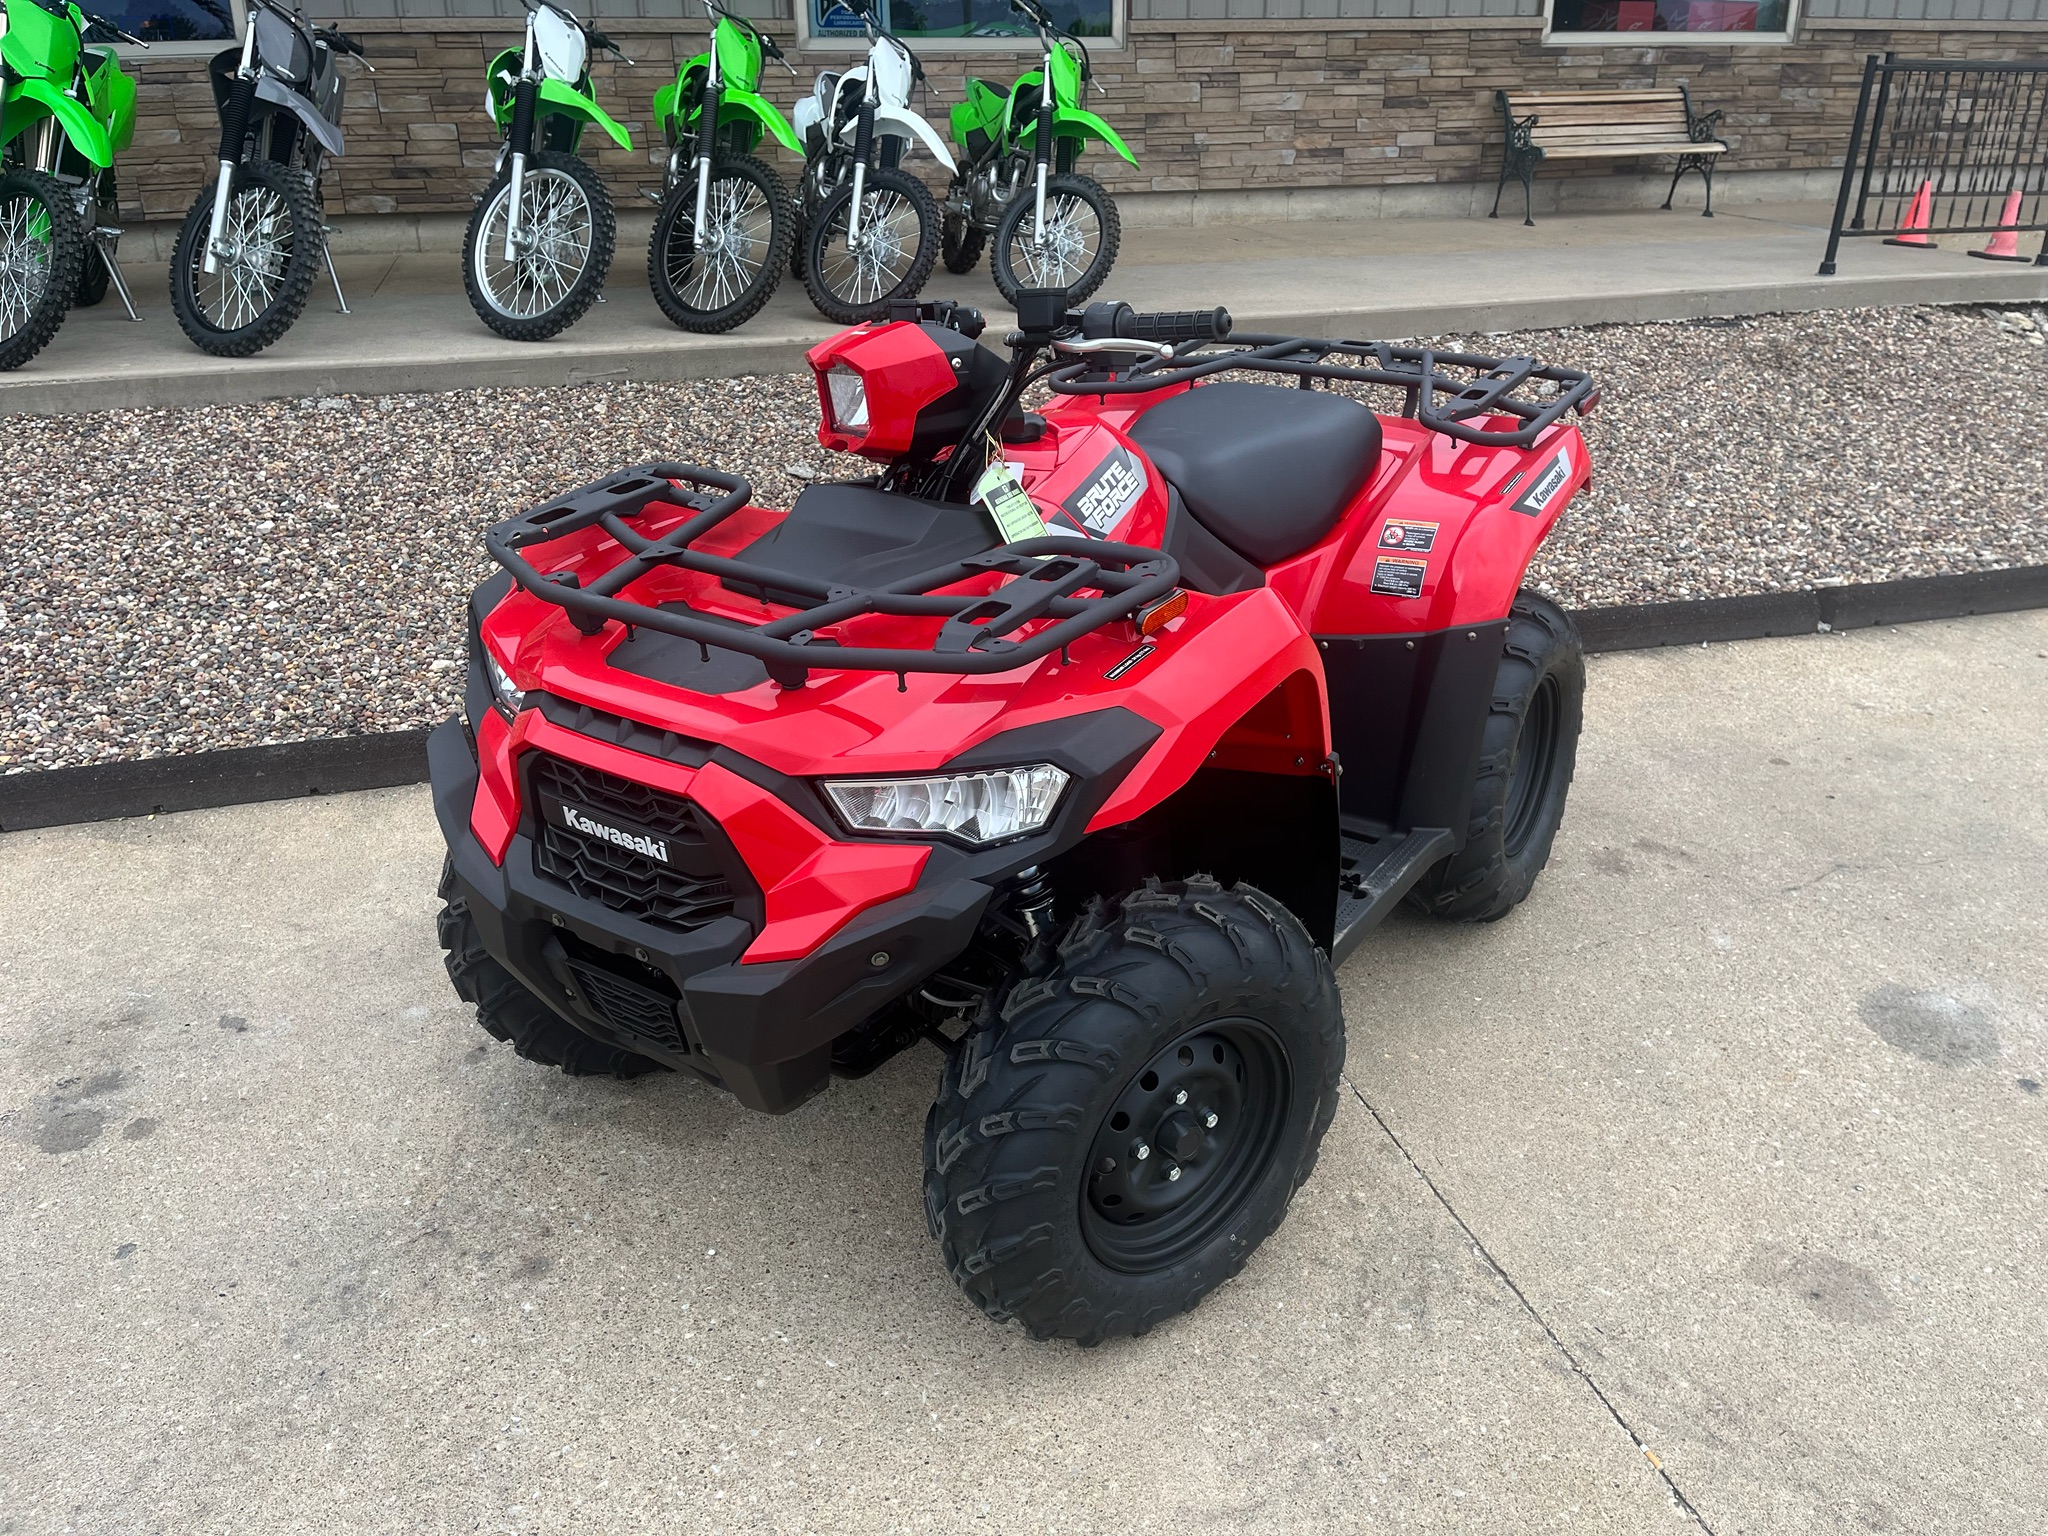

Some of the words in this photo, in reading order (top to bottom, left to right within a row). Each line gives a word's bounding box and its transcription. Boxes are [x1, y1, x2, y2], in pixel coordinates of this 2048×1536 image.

[1076, 460, 1127, 518] BRUTE
[1091, 471, 1139, 529] FORCE
[1532, 466, 1566, 507] Kawasaki
[1392, 558, 1420, 566] WARNING
[562, 805, 669, 863] Kawasaki
